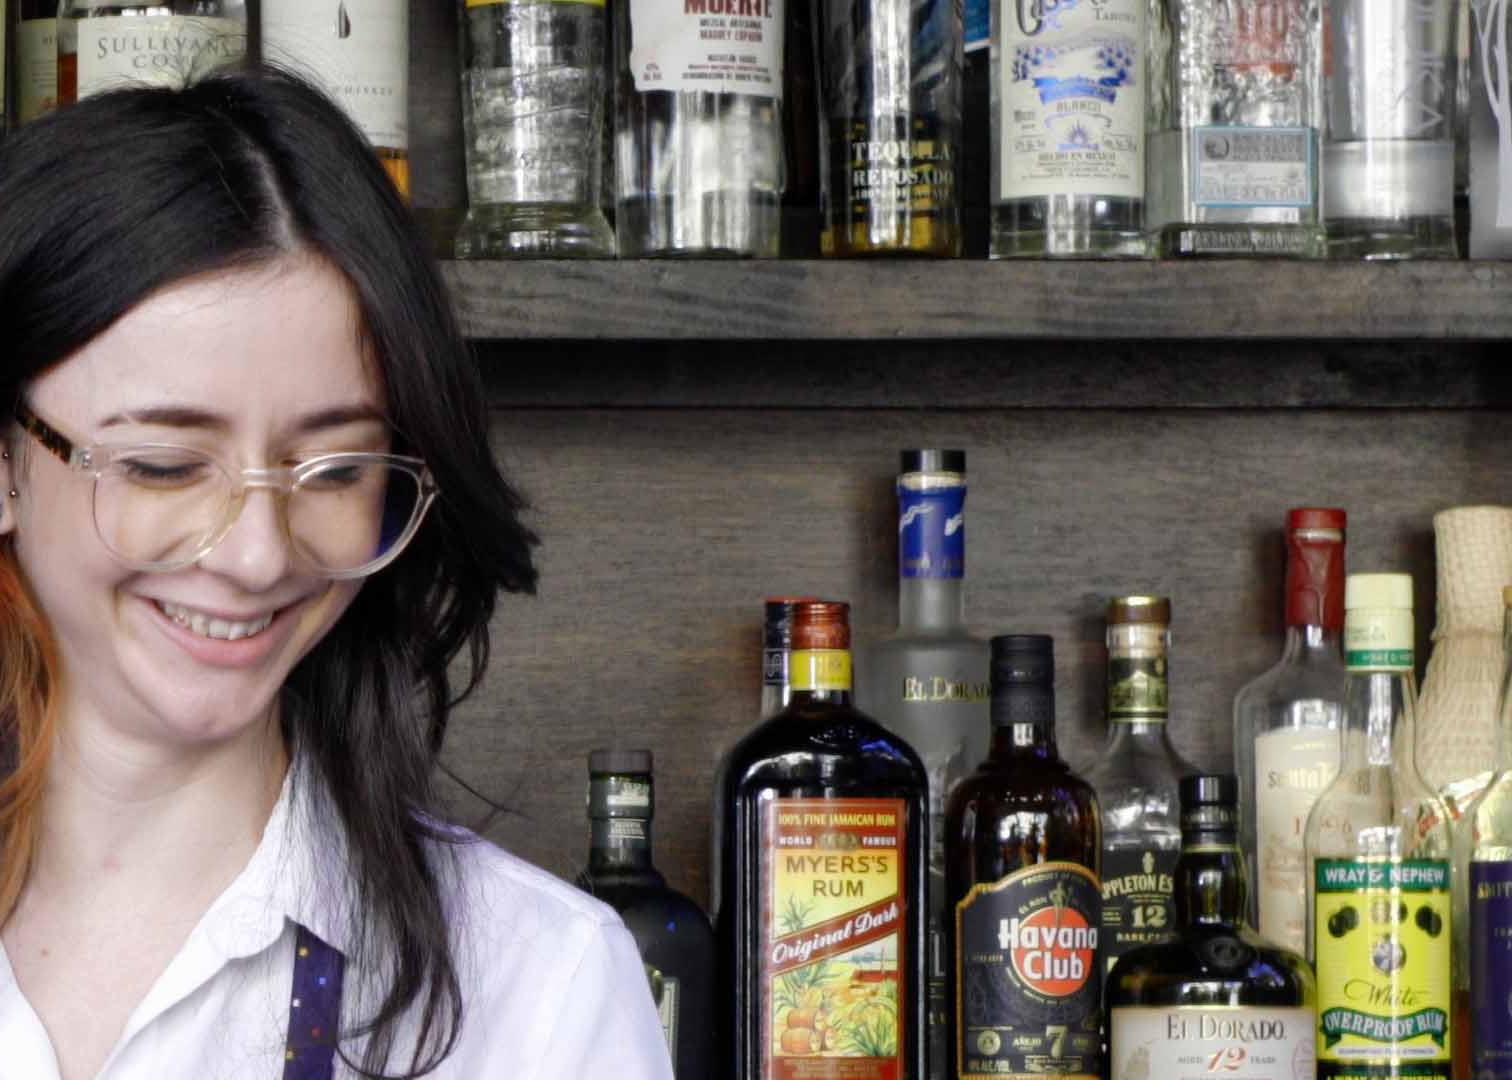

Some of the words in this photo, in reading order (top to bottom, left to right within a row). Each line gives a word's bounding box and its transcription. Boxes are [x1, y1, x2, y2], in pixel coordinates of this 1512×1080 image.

[903, 676, 927, 701] EL
[803, 813, 827, 826] FINE
[829, 813, 875, 826] JAMAICAN
[876, 813, 896, 826] RUM
[778, 835, 813, 846] WORLD
[861, 836, 897, 847] FAMOUS
[785, 855, 889, 874] MYERS'S
[1325, 867, 1366, 884] WRAY
[1368, 867, 1386, 884] &
[1389, 866, 1445, 884] NEPHEW
[812, 879, 865, 898] RUM
[1101, 872, 1156, 900] PPLETON
[1157, 874, 1175, 895] ES
[1130, 905, 1167, 929] 12
[771, 919, 854, 966] Original
[853, 901, 899, 937] Dark
[997, 917, 1098, 951] Havana
[1022, 950, 1085, 981] Club
[1166, 1013, 1192, 1041] EL
[1198, 1013, 1287, 1043] DORADO
[1323, 1010, 1415, 1039] OVERPROOF
[1416, 1012, 1445, 1035] RUM
[1044, 1024, 1069, 1059] 7
[1207, 1046, 1247, 1072] 12
